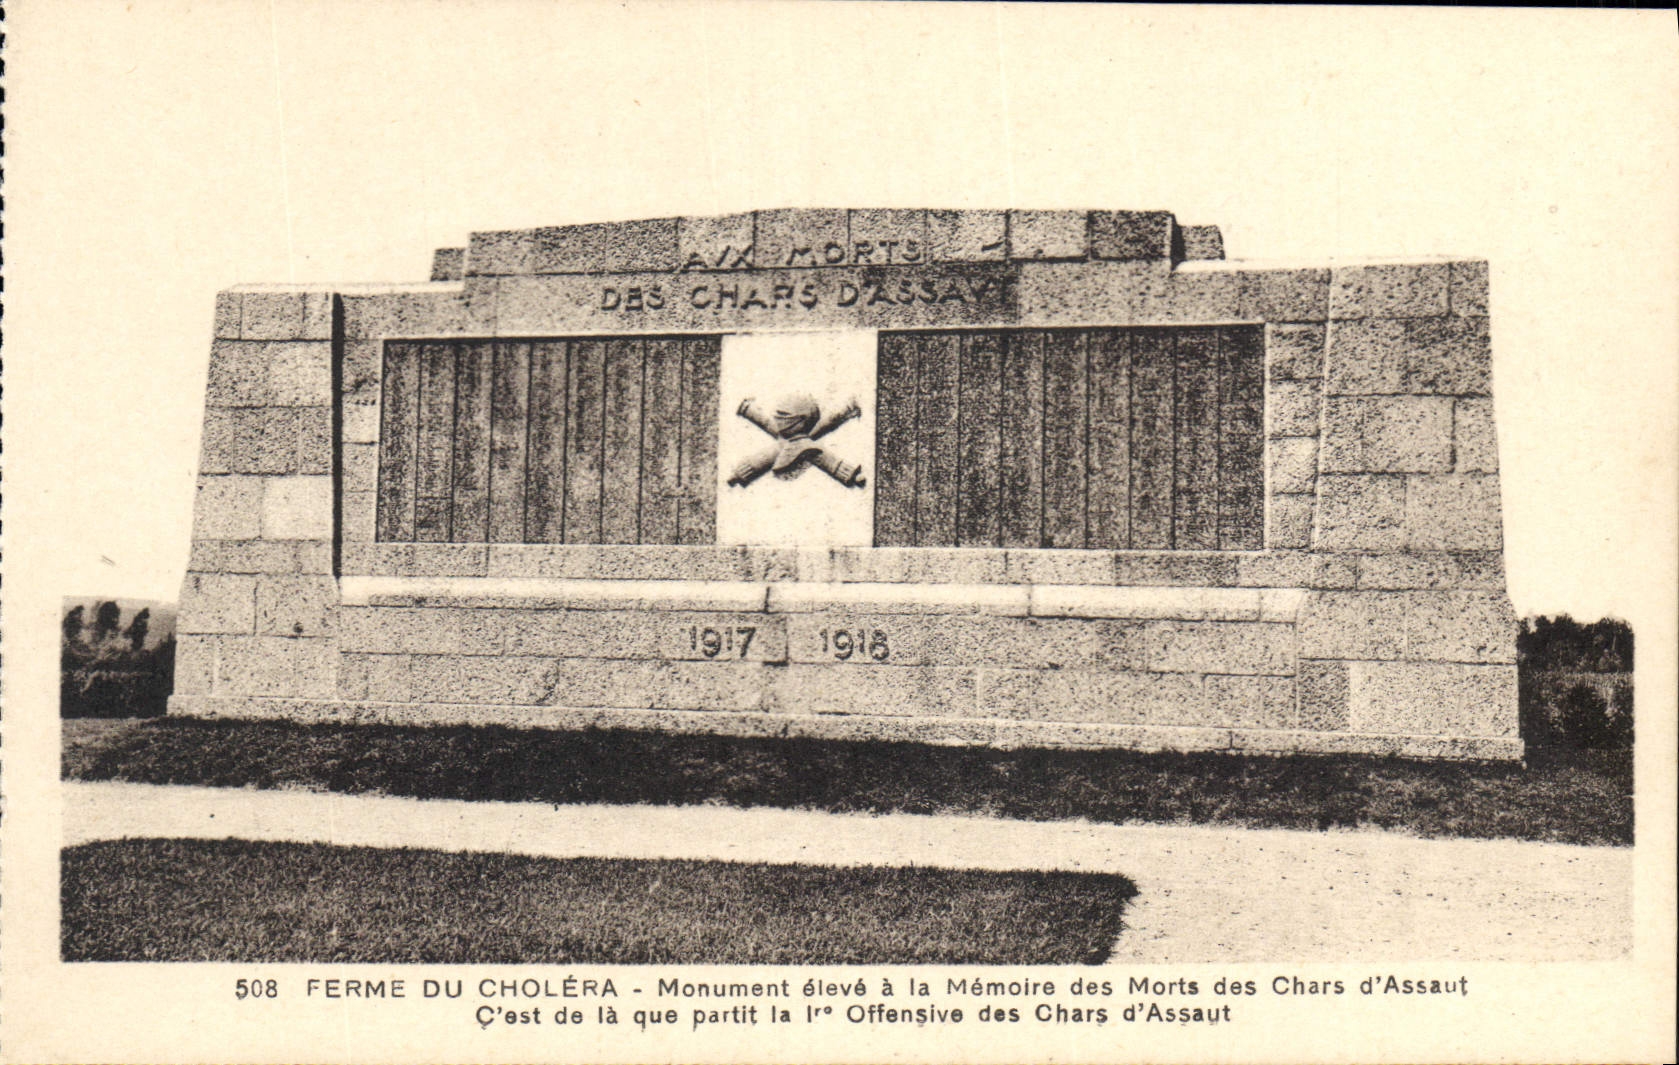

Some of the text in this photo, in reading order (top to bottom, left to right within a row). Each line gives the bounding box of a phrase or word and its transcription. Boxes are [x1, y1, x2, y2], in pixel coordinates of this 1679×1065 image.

[786, 240, 921, 267] MORTS
[600, 284, 666, 312] DES
[690, 283, 819, 312] CHARS
[689, 626, 757, 658] 1917
[819, 628, 890, 661] 1918
